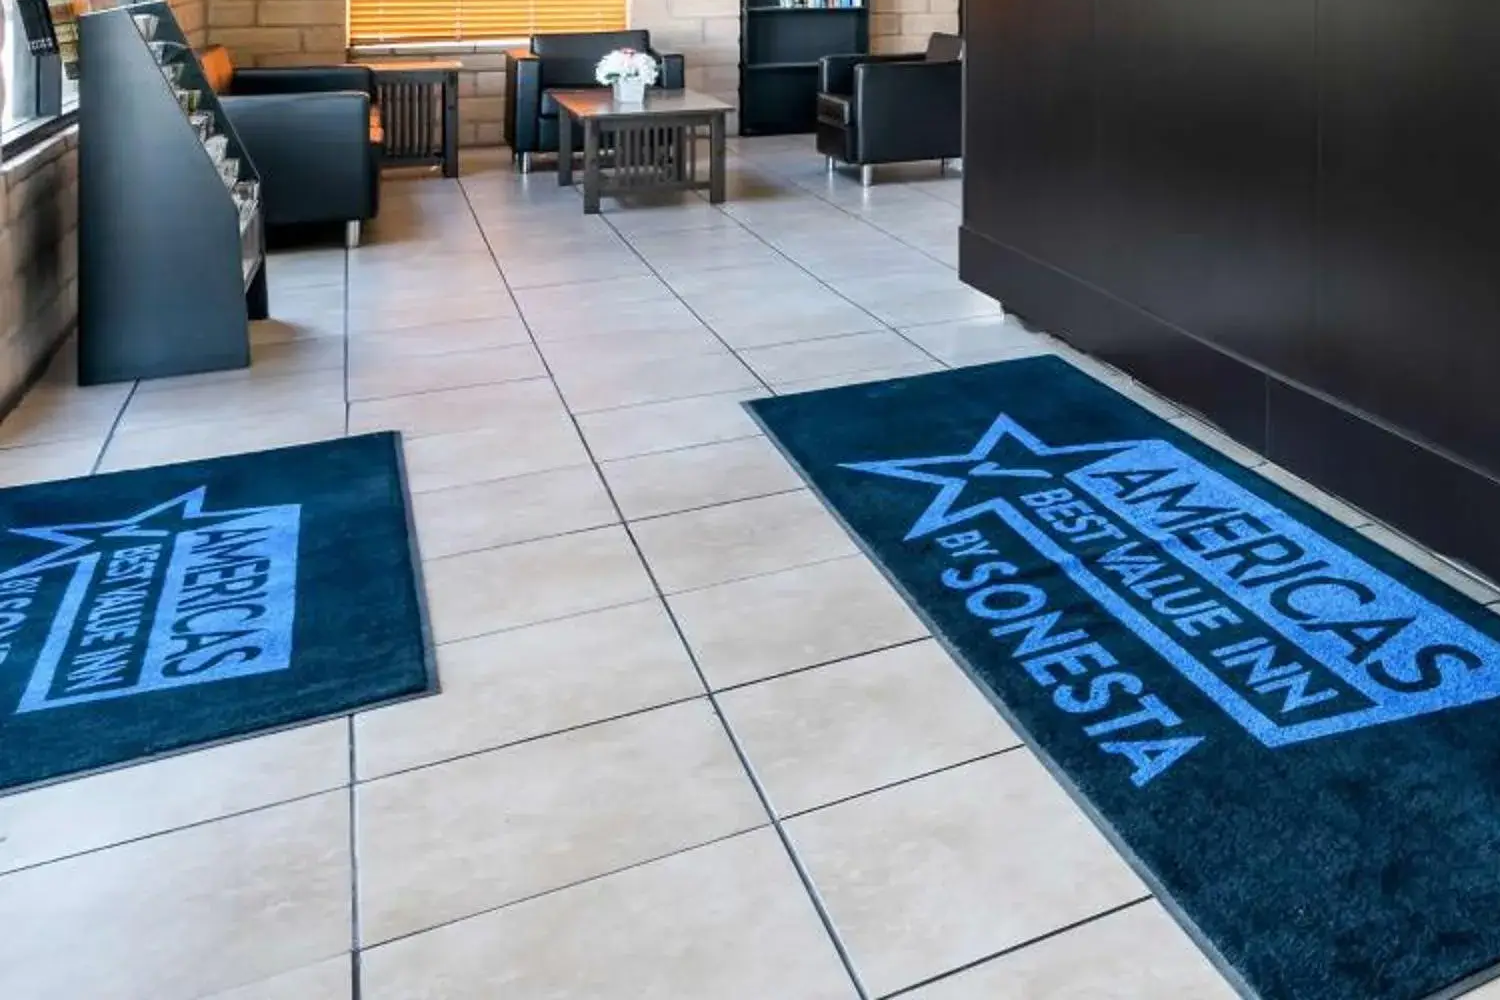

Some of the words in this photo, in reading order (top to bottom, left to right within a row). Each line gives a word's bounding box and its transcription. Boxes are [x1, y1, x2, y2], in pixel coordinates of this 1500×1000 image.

[161, 525, 275, 680] AMERICAS
[936, 529, 999, 557] BY
[1019, 487, 1126, 543] BEST
[1096, 541, 1244, 637] VALUE
[1211, 637, 1339, 713] INN
[1088, 468, 1482, 692] AMERICAS
[64, 643, 135, 692] INN
[941, 561, 1206, 788] SONESTA
